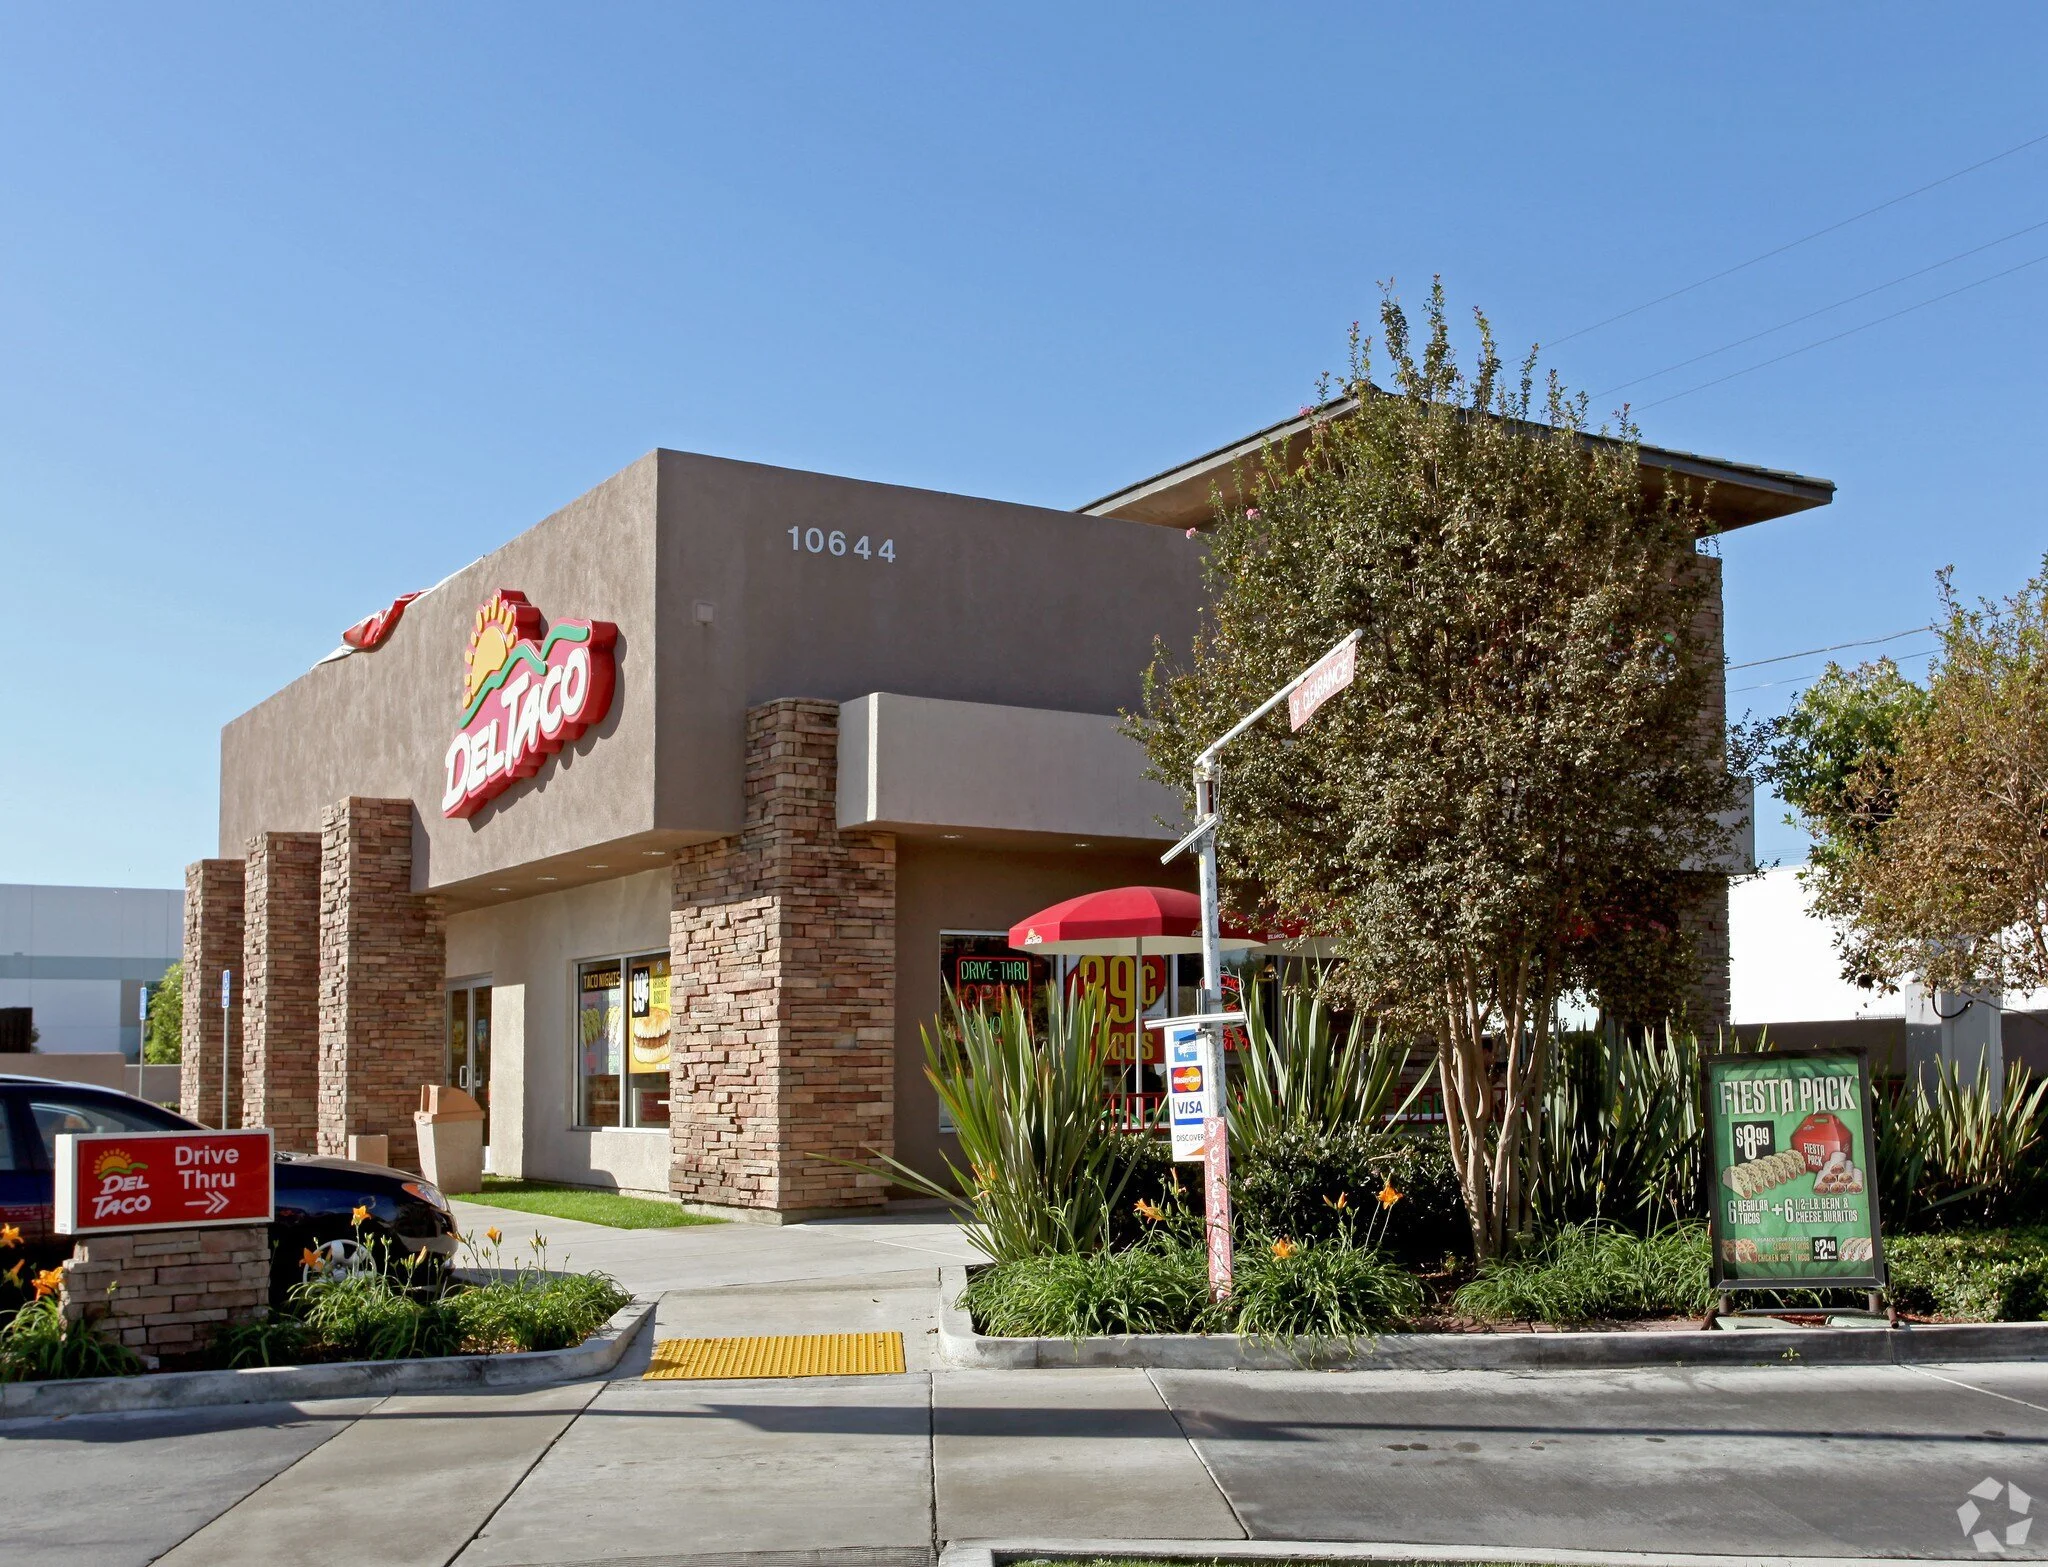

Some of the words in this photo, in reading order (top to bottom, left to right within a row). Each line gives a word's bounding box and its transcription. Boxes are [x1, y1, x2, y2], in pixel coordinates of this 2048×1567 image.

[787, 525, 896, 563] 10644
[1303, 661, 1348, 712] CLEARANCE
[442, 718, 505, 812] DEL
[501, 648, 587, 771] TACO
[584, 974, 598, 989] TACO
[599, 971, 620, 987] NIGHTS
[960, 961, 1030, 981] DRIVE-THRU
[1173, 1076, 1201, 1085] MasterCard
[1719, 1079, 1795, 1116] FIESTA
[1799, 1075, 1857, 1115] PACK
[1178, 1101, 1203, 1114] VISA
[1176, 1133, 1205, 1142] DISCOVER
[175, 1145, 239, 1166] Drive
[1804, 1143, 1825, 1156] FIESTA
[1807, 1154, 1823, 1167] PACK
[100, 1175, 149, 1195] DEL
[178, 1170, 236, 1190] Thru
[92, 1195, 151, 1220] TACO
[1727, 1200, 1737, 1224] 6
[1738, 1200, 1769, 1212] REGULAR
[1784, 1199, 1794, 1223] 6
[1821, 1198, 1840, 1210] BEAN
[1739, 1212, 1761, 1225] TACOS
[1795, 1211, 1822, 1223] CHEESE
[1823, 1209, 1858, 1223] BURRITOS
